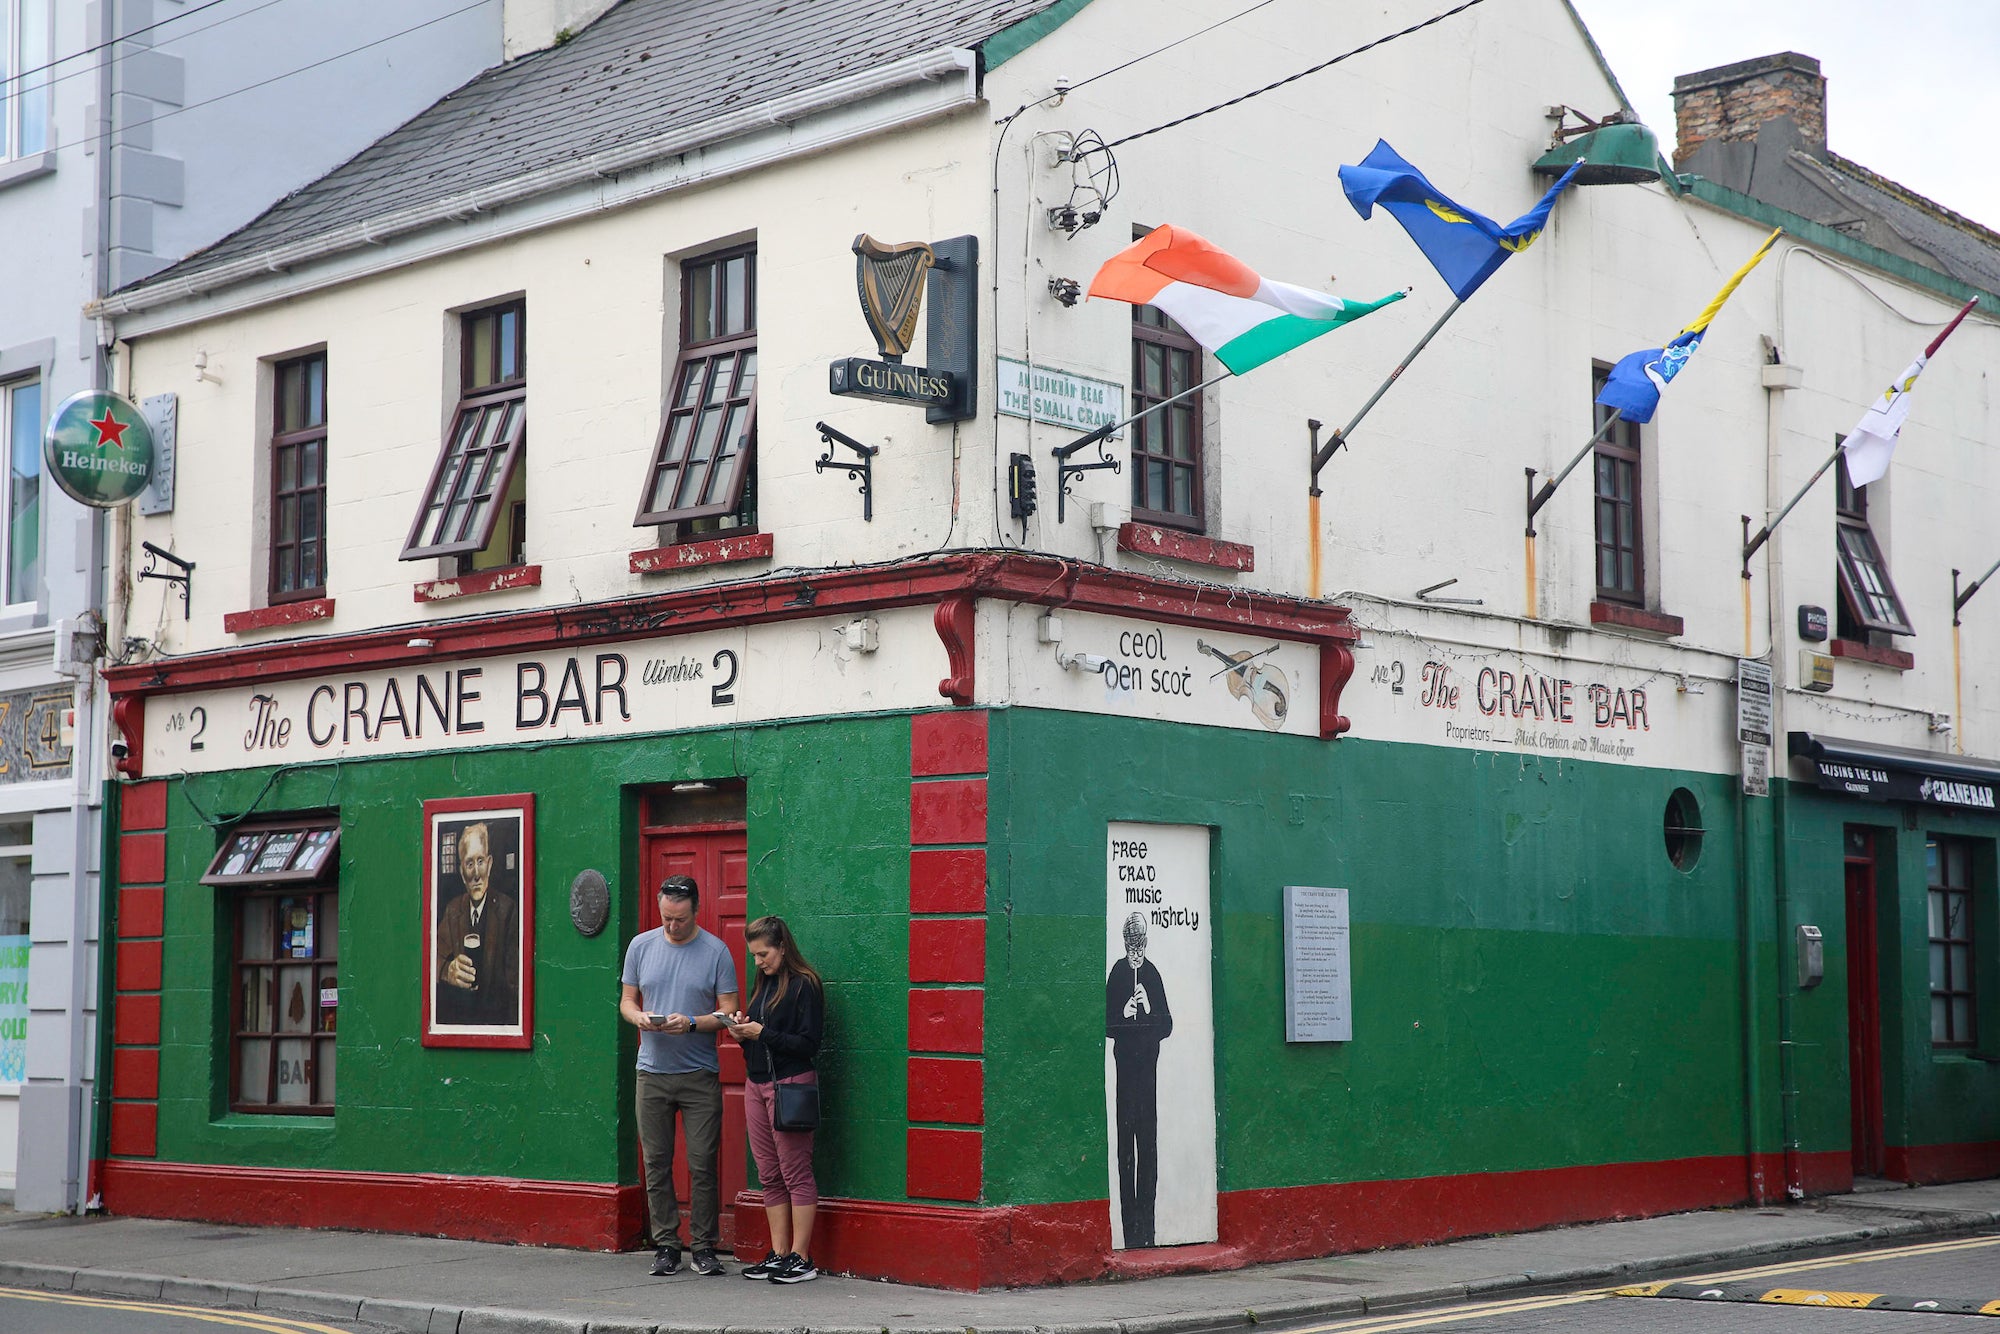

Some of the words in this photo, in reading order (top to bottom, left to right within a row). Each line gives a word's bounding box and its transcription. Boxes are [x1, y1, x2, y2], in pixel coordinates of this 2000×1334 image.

[857, 364, 948, 398] GUINNESS
[1081, 385, 1104, 405] BEAG
[1004, 390, 1029, 411] THE
[1034, 397, 1074, 421] SMALL
[62, 451, 147, 476] Heineken
[1119, 628, 1167, 661] ceol
[189, 706, 208, 752] 2
[244, 692, 292, 752] The
[307, 667, 485, 749] CRANE
[516, 653, 632, 731] BAR
[711, 649, 739, 707] 2
[1391, 660, 1405, 695] 2
[1421, 660, 1461, 709] The
[1477, 666, 1574, 723] CRANE
[1588, 683, 1651, 731] BAR
[40, 710, 58, 752] 4
[1446, 721, 1490, 742] Proprietors
[1514, 727, 1538, 747] Mick
[1572, 736, 1588, 751] and
[1845, 782, 1869, 793] GUINNESS
[1855, 768, 1871, 781] THE
[1873, 770, 1889, 783] BAR
[1118, 865, 1156, 882] TRAD
[1151, 905, 1199, 931] nightly
